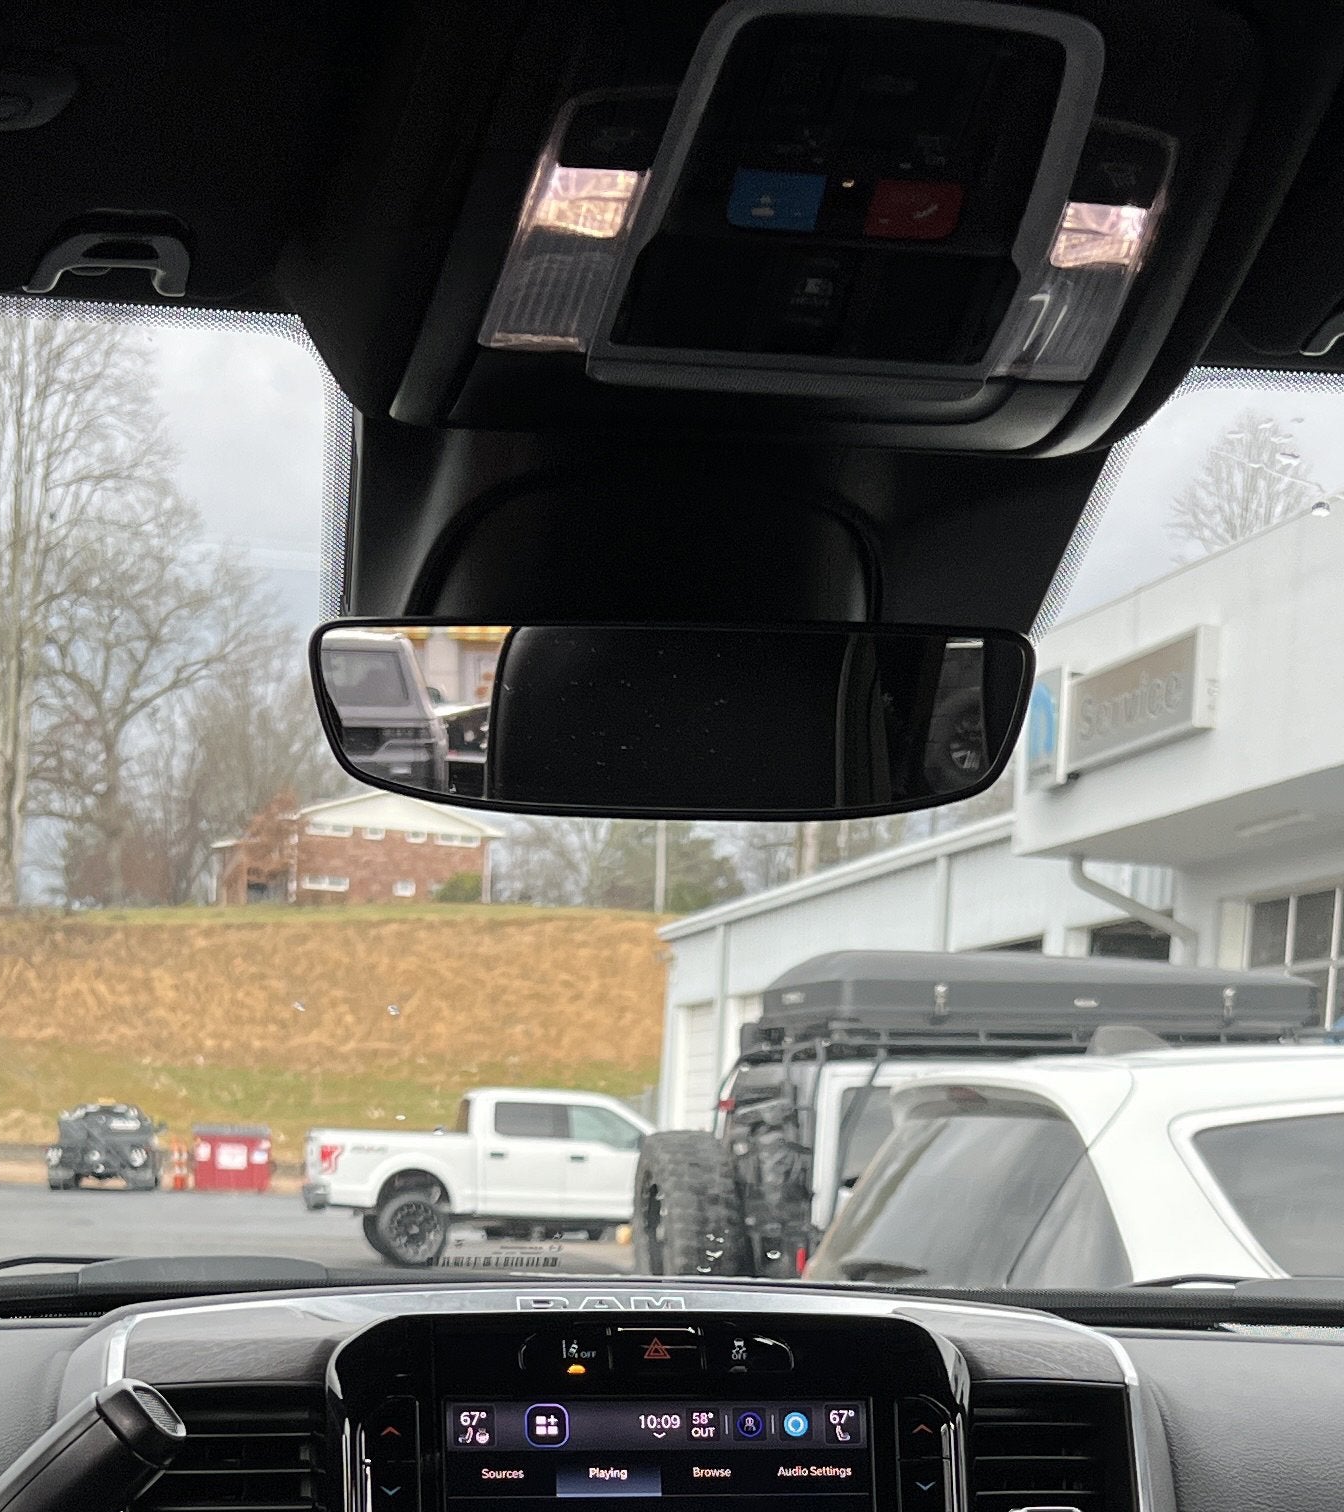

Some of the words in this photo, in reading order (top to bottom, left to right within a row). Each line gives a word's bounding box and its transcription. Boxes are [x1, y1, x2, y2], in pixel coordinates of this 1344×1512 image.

[1079, 668, 1182, 740] Service
[516, 1295, 687, 1311] RAM
[460, 1411, 487, 1426] 67°
[638, 1413, 681, 1429] 10:09
[691, 1411, 714, 1425] 58°
[830, 1409, 855, 1424] 67°
[691, 1426, 716, 1437] OUT
[481, 1467, 524, 1479] Sources
[589, 1466, 628, 1480] Playing
[692, 1466, 732, 1477] Browse
[777, 1465, 808, 1476] Audio
[809, 1465, 853, 1478] Settings
